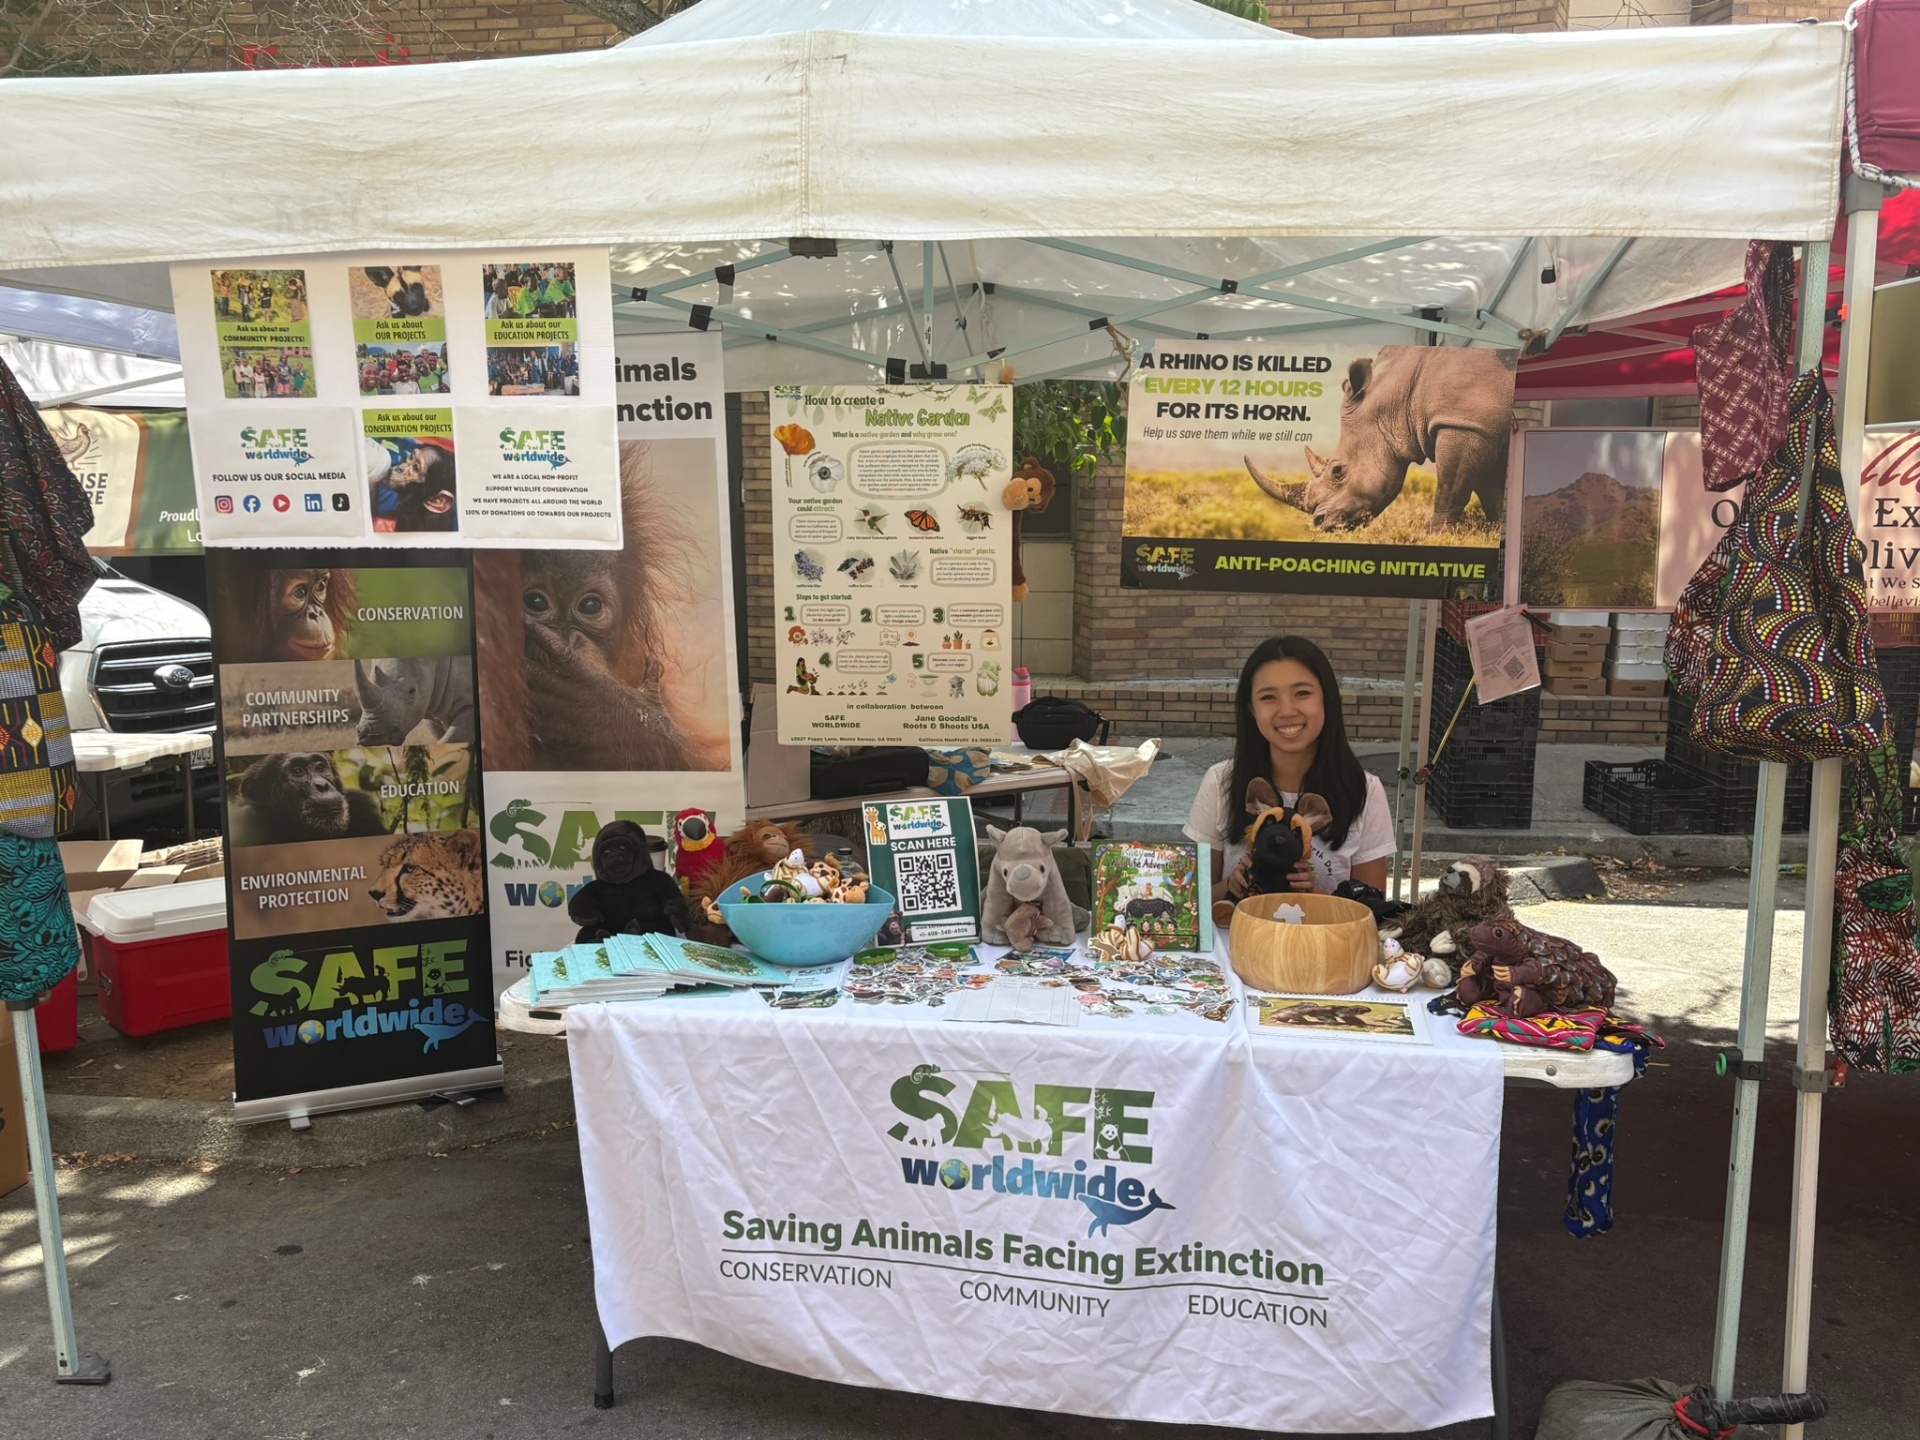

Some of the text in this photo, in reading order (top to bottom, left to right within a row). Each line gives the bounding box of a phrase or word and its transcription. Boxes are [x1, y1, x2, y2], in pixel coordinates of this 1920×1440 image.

[402, 320, 423, 328] about
[526, 320, 546, 328] about
[393, 331, 426, 340] PROJECTS
[494, 331, 569, 340] EDUCATION PROJECTS
[615, 357, 697, 382] imals
[1139, 353, 1332, 373] A RHINO IS KILLED
[1144, 377, 1323, 397] EVERY 12 HOURS
[617, 395, 712, 421] nction
[805, 395, 828, 405] How
[831, 396, 841, 405] to
[844, 396, 876, 405] create
[879, 397, 884, 405] a
[402, 413, 423, 421] about
[865, 408, 970, 427] Native Garden
[1156, 402, 1311, 422] FOR ITS HORN.
[364, 424, 452, 434] CONSERVATION PROJECTS
[913, 431, 926, 439] why
[1143, 427, 1312, 442] Help us save them while we still can
[241, 428, 308, 448] SAFE
[500, 428, 566, 450] SAFE
[245, 448, 307, 459] worldwide
[503, 451, 564, 461] worldwide
[264, 473, 283, 481] OUR
[319, 472, 346, 480] MEDIA
[159, 509, 200, 521] Proudl
[1711, 498, 1920, 528] O Ex
[1135, 543, 1195, 564] SAFE
[1863, 540, 1920, 570] liv
[1138, 563, 1192, 574] worldwide
[1215, 555, 1486, 579] ANTI-POACHING INITIATIVE
[1881, 578, 1906, 589] We
[357, 606, 463, 622] CONSERVATION
[784, 606, 795, 621] 1
[861, 608, 872, 622] 2
[933, 608, 944, 623] 3
[819, 652, 831, 667] 4
[912, 654, 923, 668] 5
[246, 689, 340, 706] COMMUNITY
[242, 709, 349, 727] PARTNERSHIPS
[381, 780, 460, 798] EDUCATION
[889, 805, 942, 821] SAFE
[893, 819, 942, 831] worldwide
[891, 837, 956, 851] SCAN HERE
[240, 866, 367, 891] ENVIRONMENTAL
[259, 887, 349, 910] PROTECTION
[250, 939, 470, 1016] SAFE
[263, 998, 465, 1049] worldwide
[887, 1070, 1155, 1164] SAFE
[900, 1155, 1146, 1207] worldwide
[722, 1209, 1324, 1286] Saving Animals Facing Extinction
[719, 1259, 1328, 1328] CONSERVATION COMMUNITY EDUCATION
